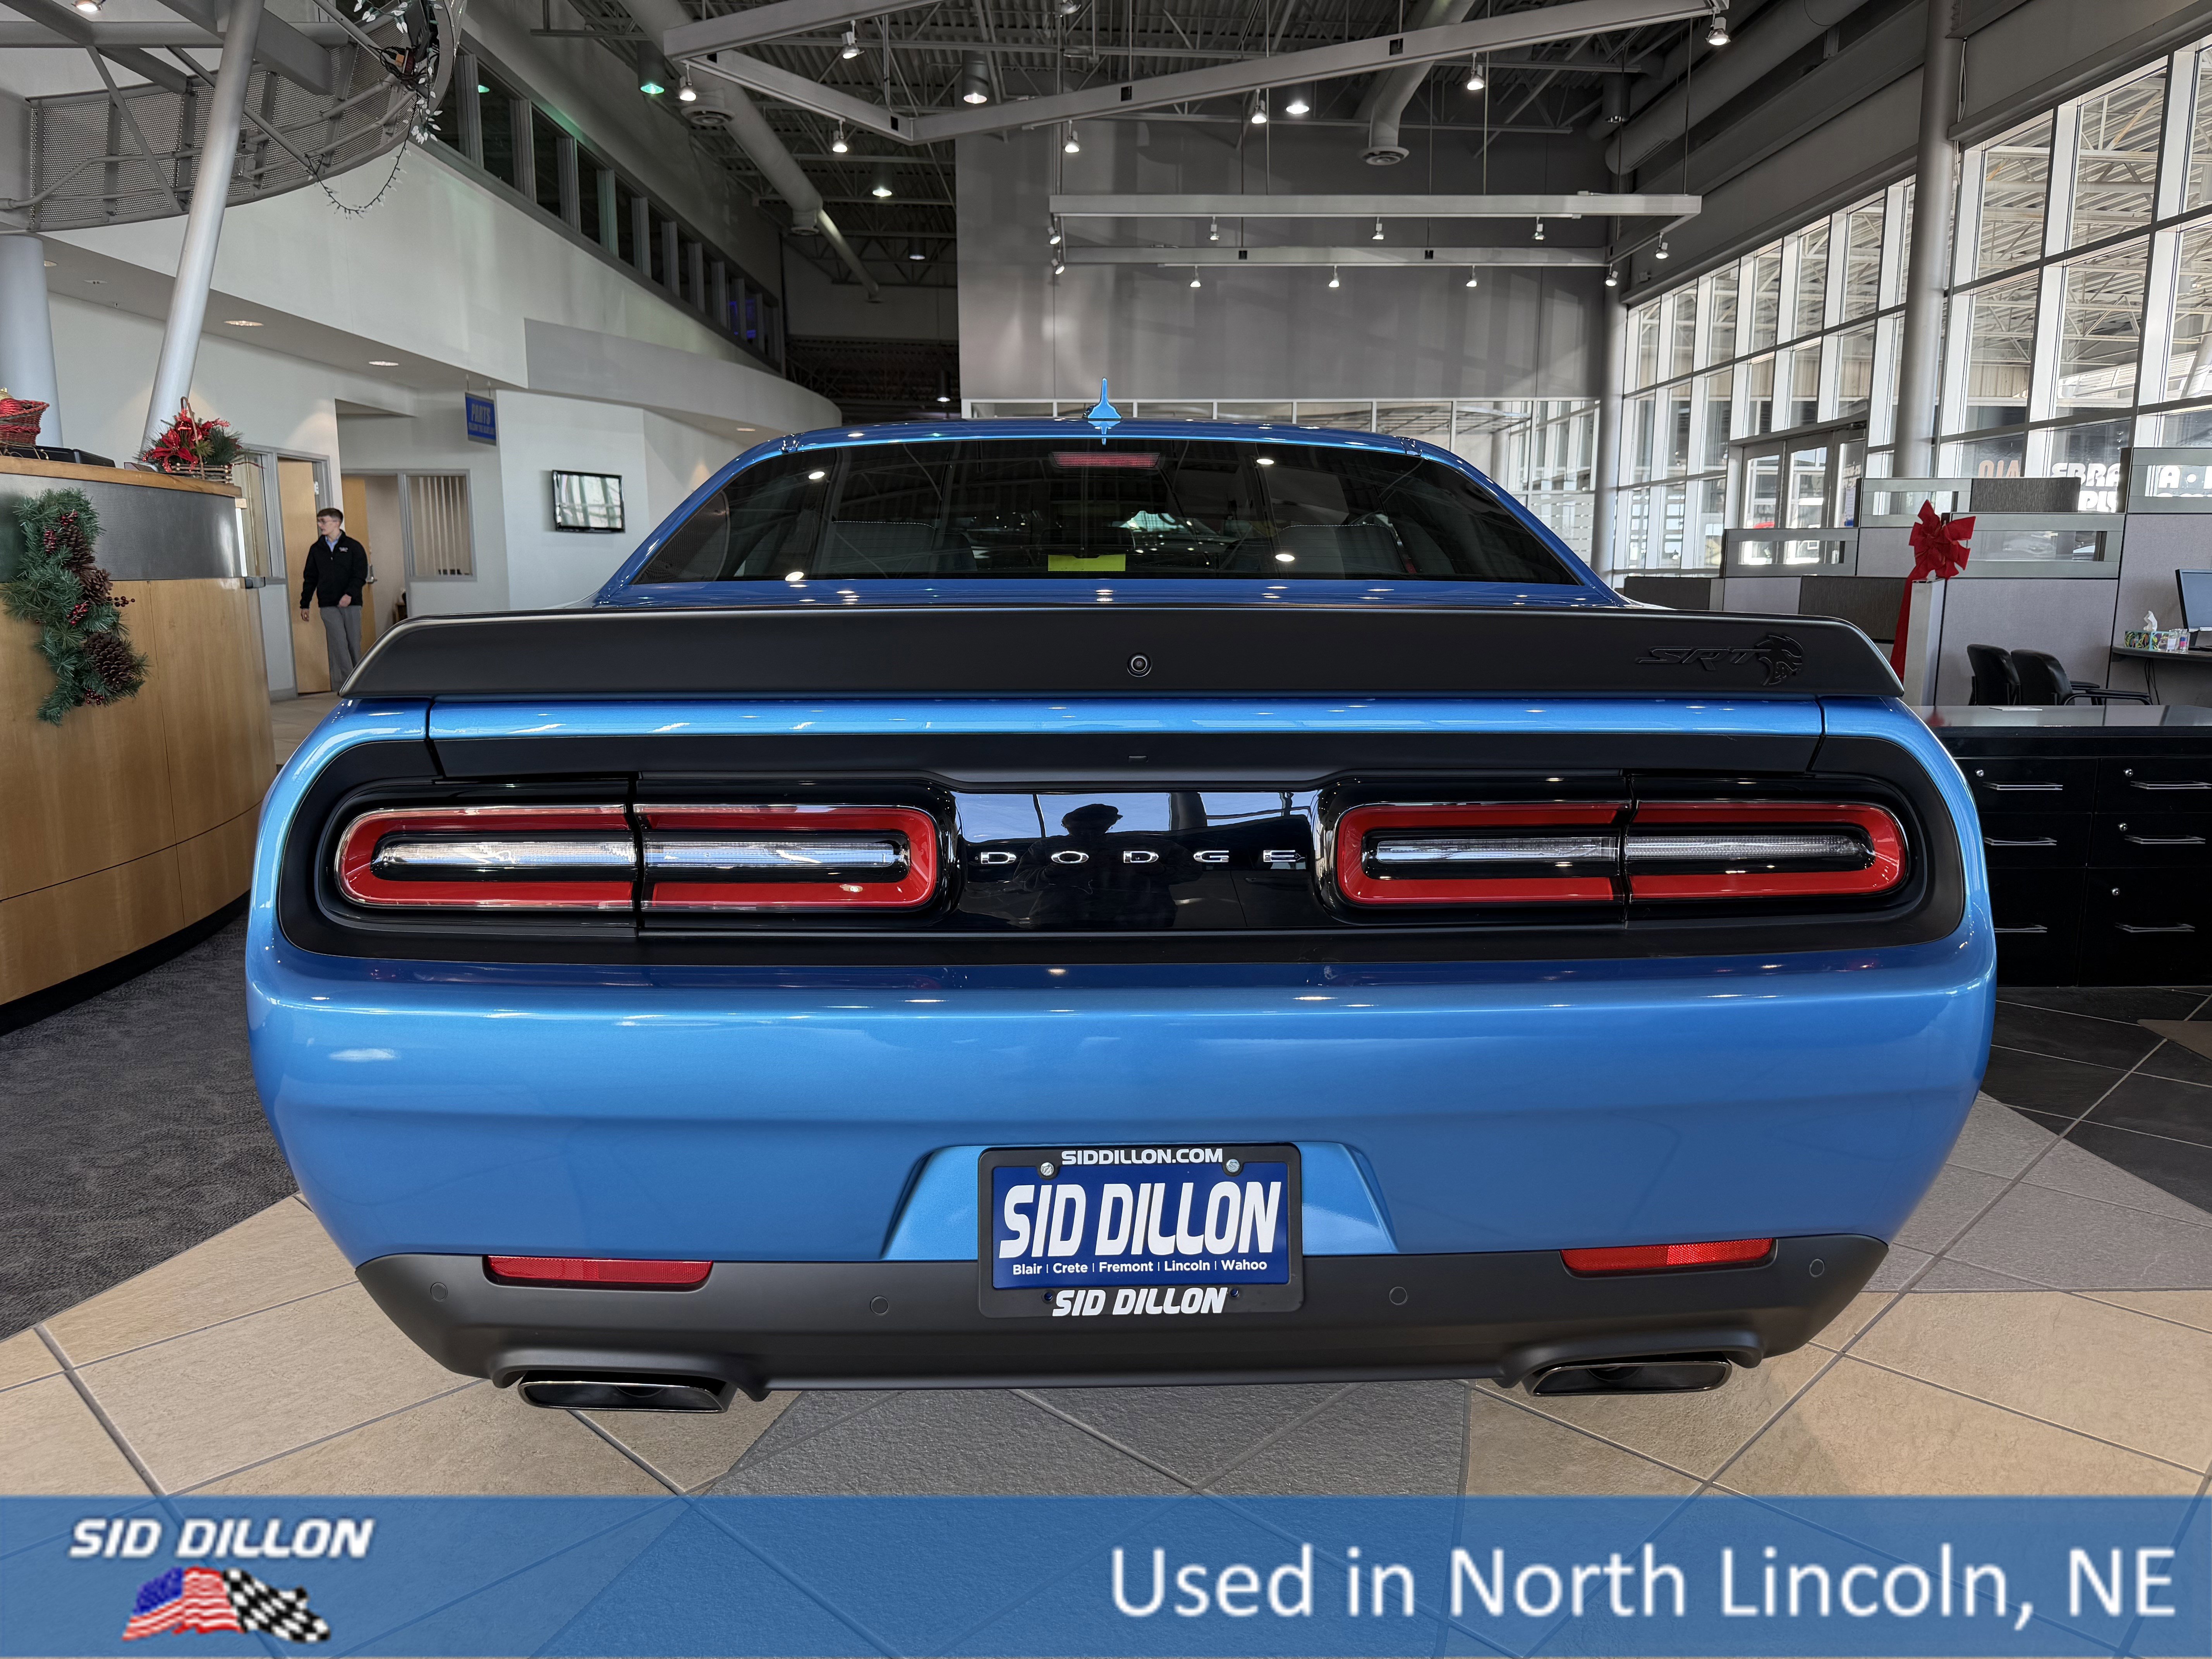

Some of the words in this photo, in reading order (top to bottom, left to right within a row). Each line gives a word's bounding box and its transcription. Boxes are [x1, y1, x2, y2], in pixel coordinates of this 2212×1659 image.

[471, 403, 491, 425] PARTS
[1635, 647, 1771, 671] SRT
[980, 850, 1299, 865] DODGE
[1061, 1148, 1223, 1165] SIDDILLON.COM
[999, 1184, 1086, 1259] SID
[1095, 1181, 1281, 1255] DILLON
[1013, 1263, 1042, 1275] Blair
[1053, 1262, 1088, 1274] Crete
[1099, 1261, 1153, 1273] Fremont
[1164, 1260, 1210, 1271] Lincoln
[1221, 1259, 1267, 1271] Wahoo
[1052, 1290, 1106, 1317] SID
[1112, 1287, 1228, 1315] DILLON
